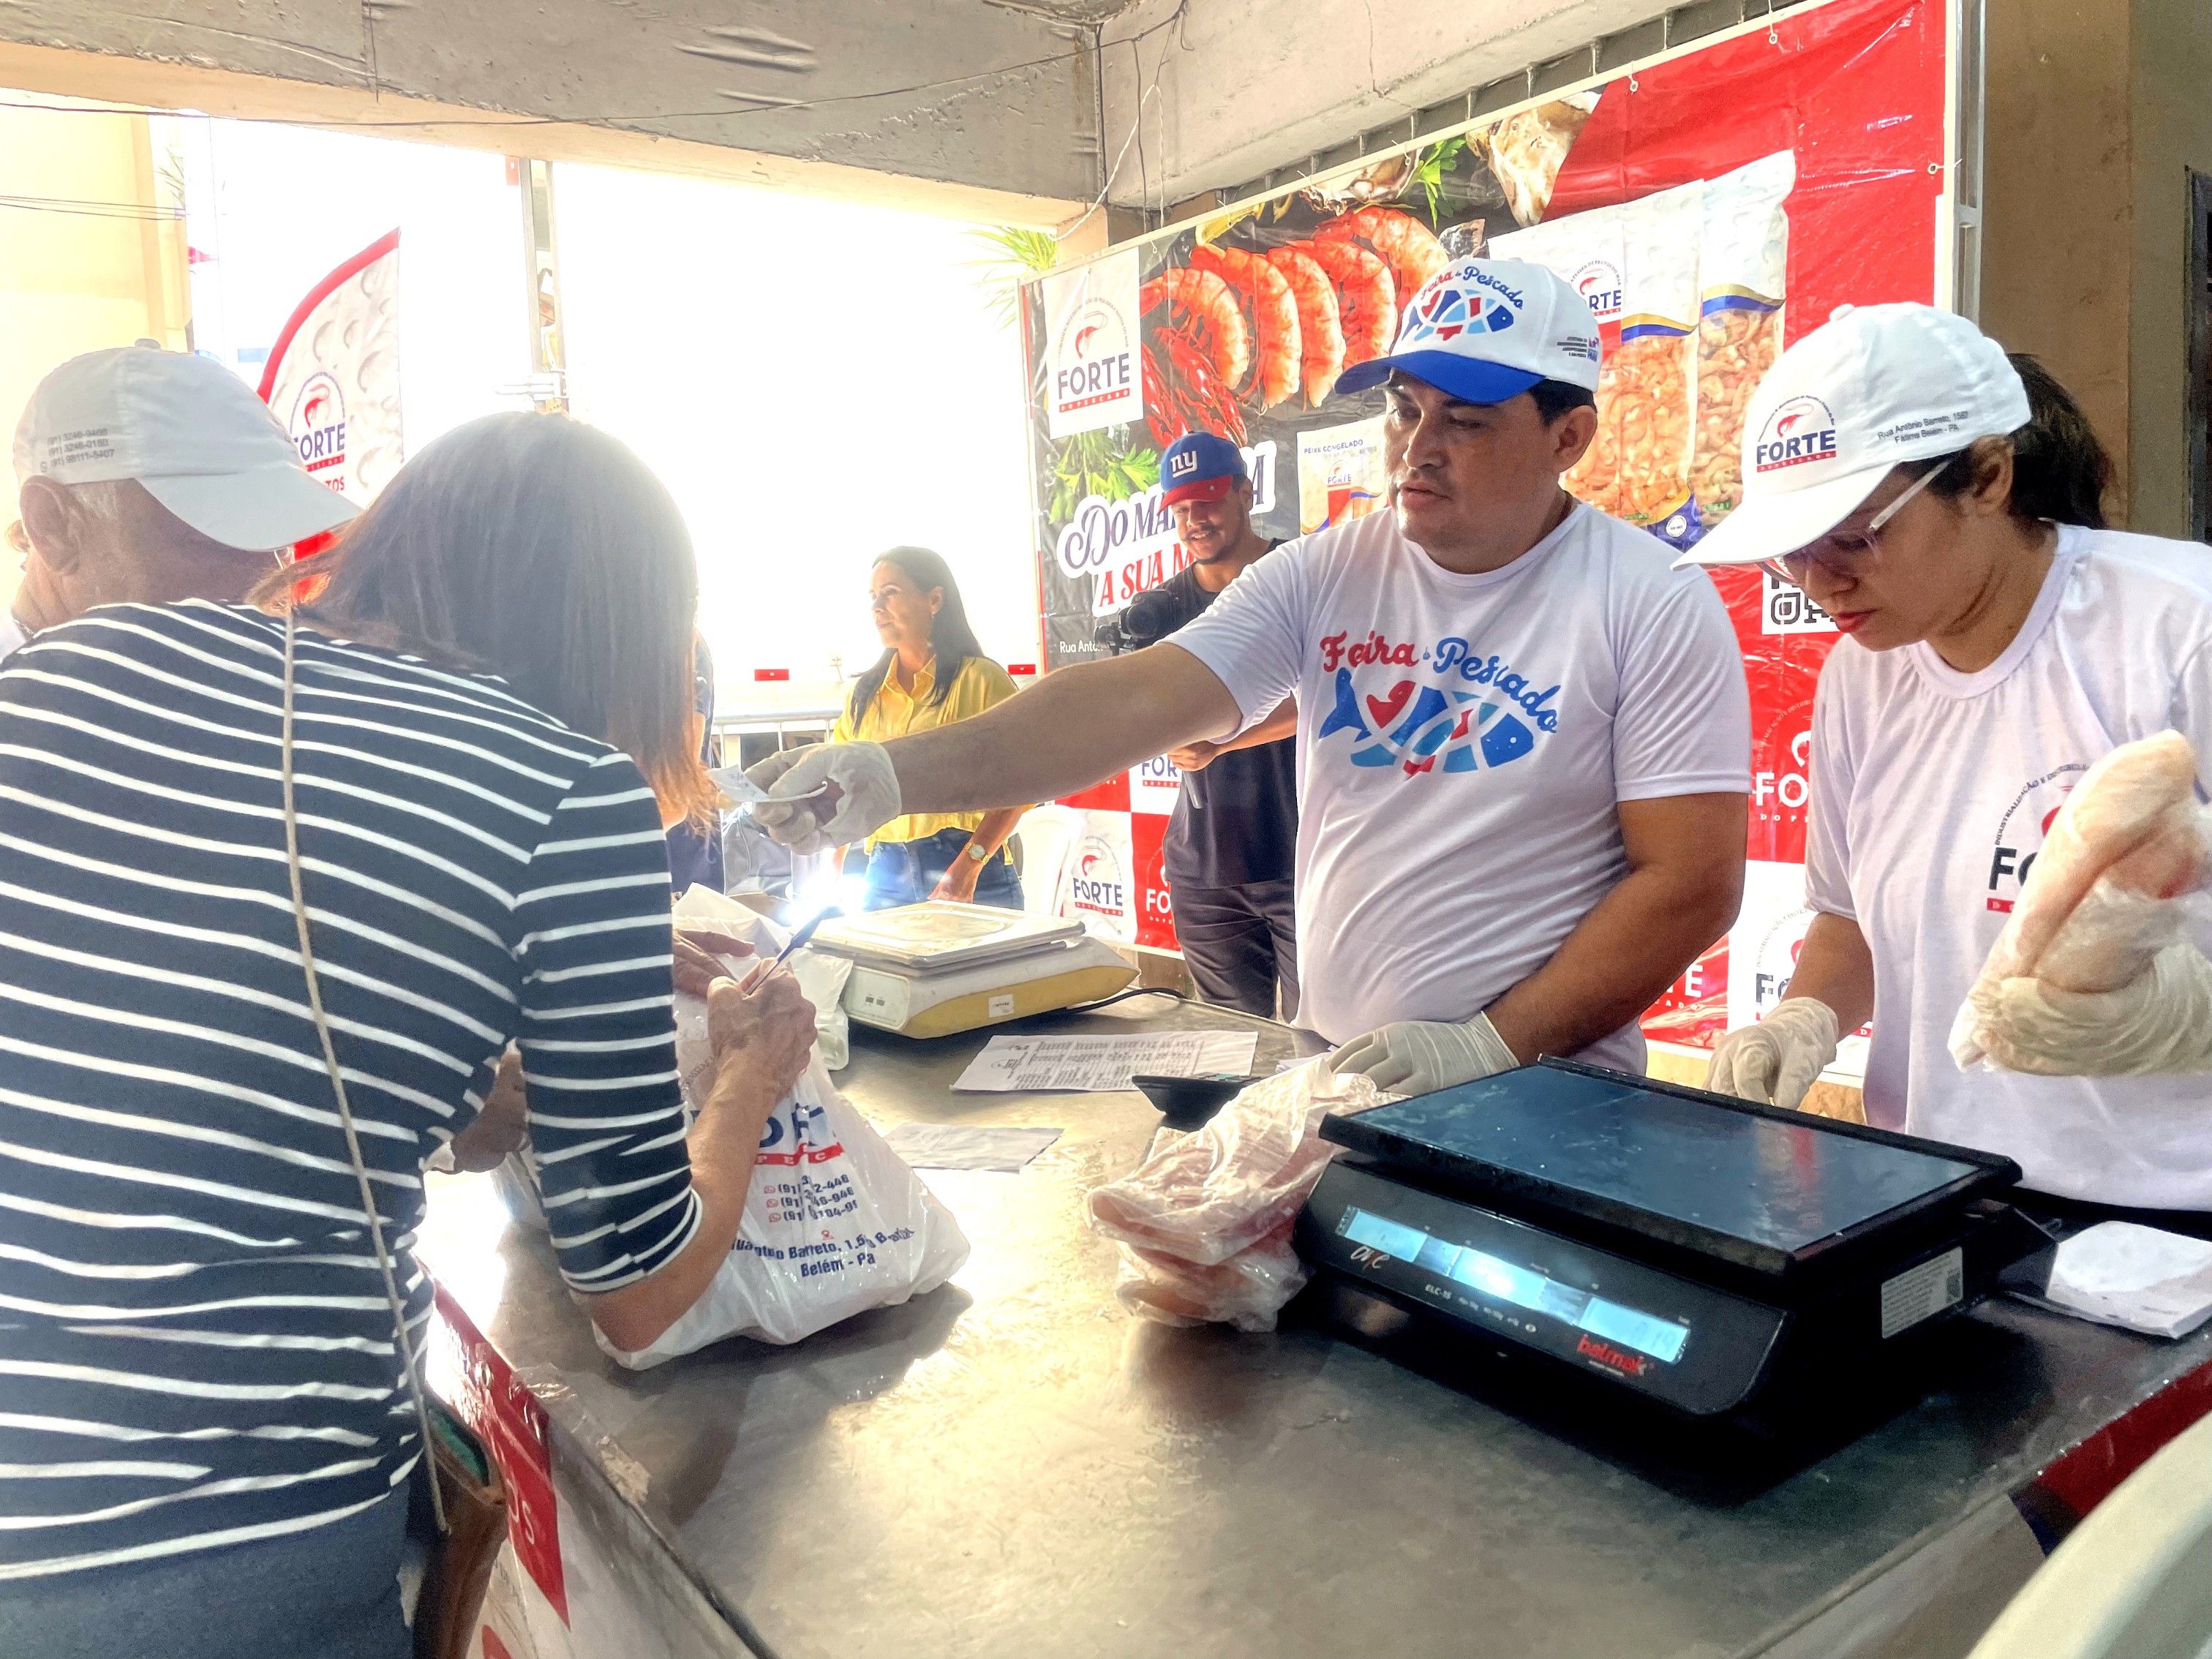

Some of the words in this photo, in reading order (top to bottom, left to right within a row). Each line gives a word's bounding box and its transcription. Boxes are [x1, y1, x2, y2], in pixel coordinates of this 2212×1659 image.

[1463, 266, 1524, 310] Pescado
[1589, 290, 1622, 310] RTE
[1058, 353, 1130, 400] FORTE
[293, 423, 345, 461] ORTE
[1756, 429, 1836, 465] FORTE
[1065, 504, 1129, 570] DO
[1132, 491, 1175, 543] MA
[1099, 570, 1116, 607] A
[1121, 549, 1165, 600] SUA
[1059, 640, 1077, 653] Rua
[1320, 630, 1419, 673] Feira
[1433, 636, 1562, 734] Pescado
[1141, 756, 1178, 778] FOR
[1072, 877, 1123, 907] FORTE
[800, 1258, 844, 1278] Belém
[857, 1251, 876, 1267] Pa
